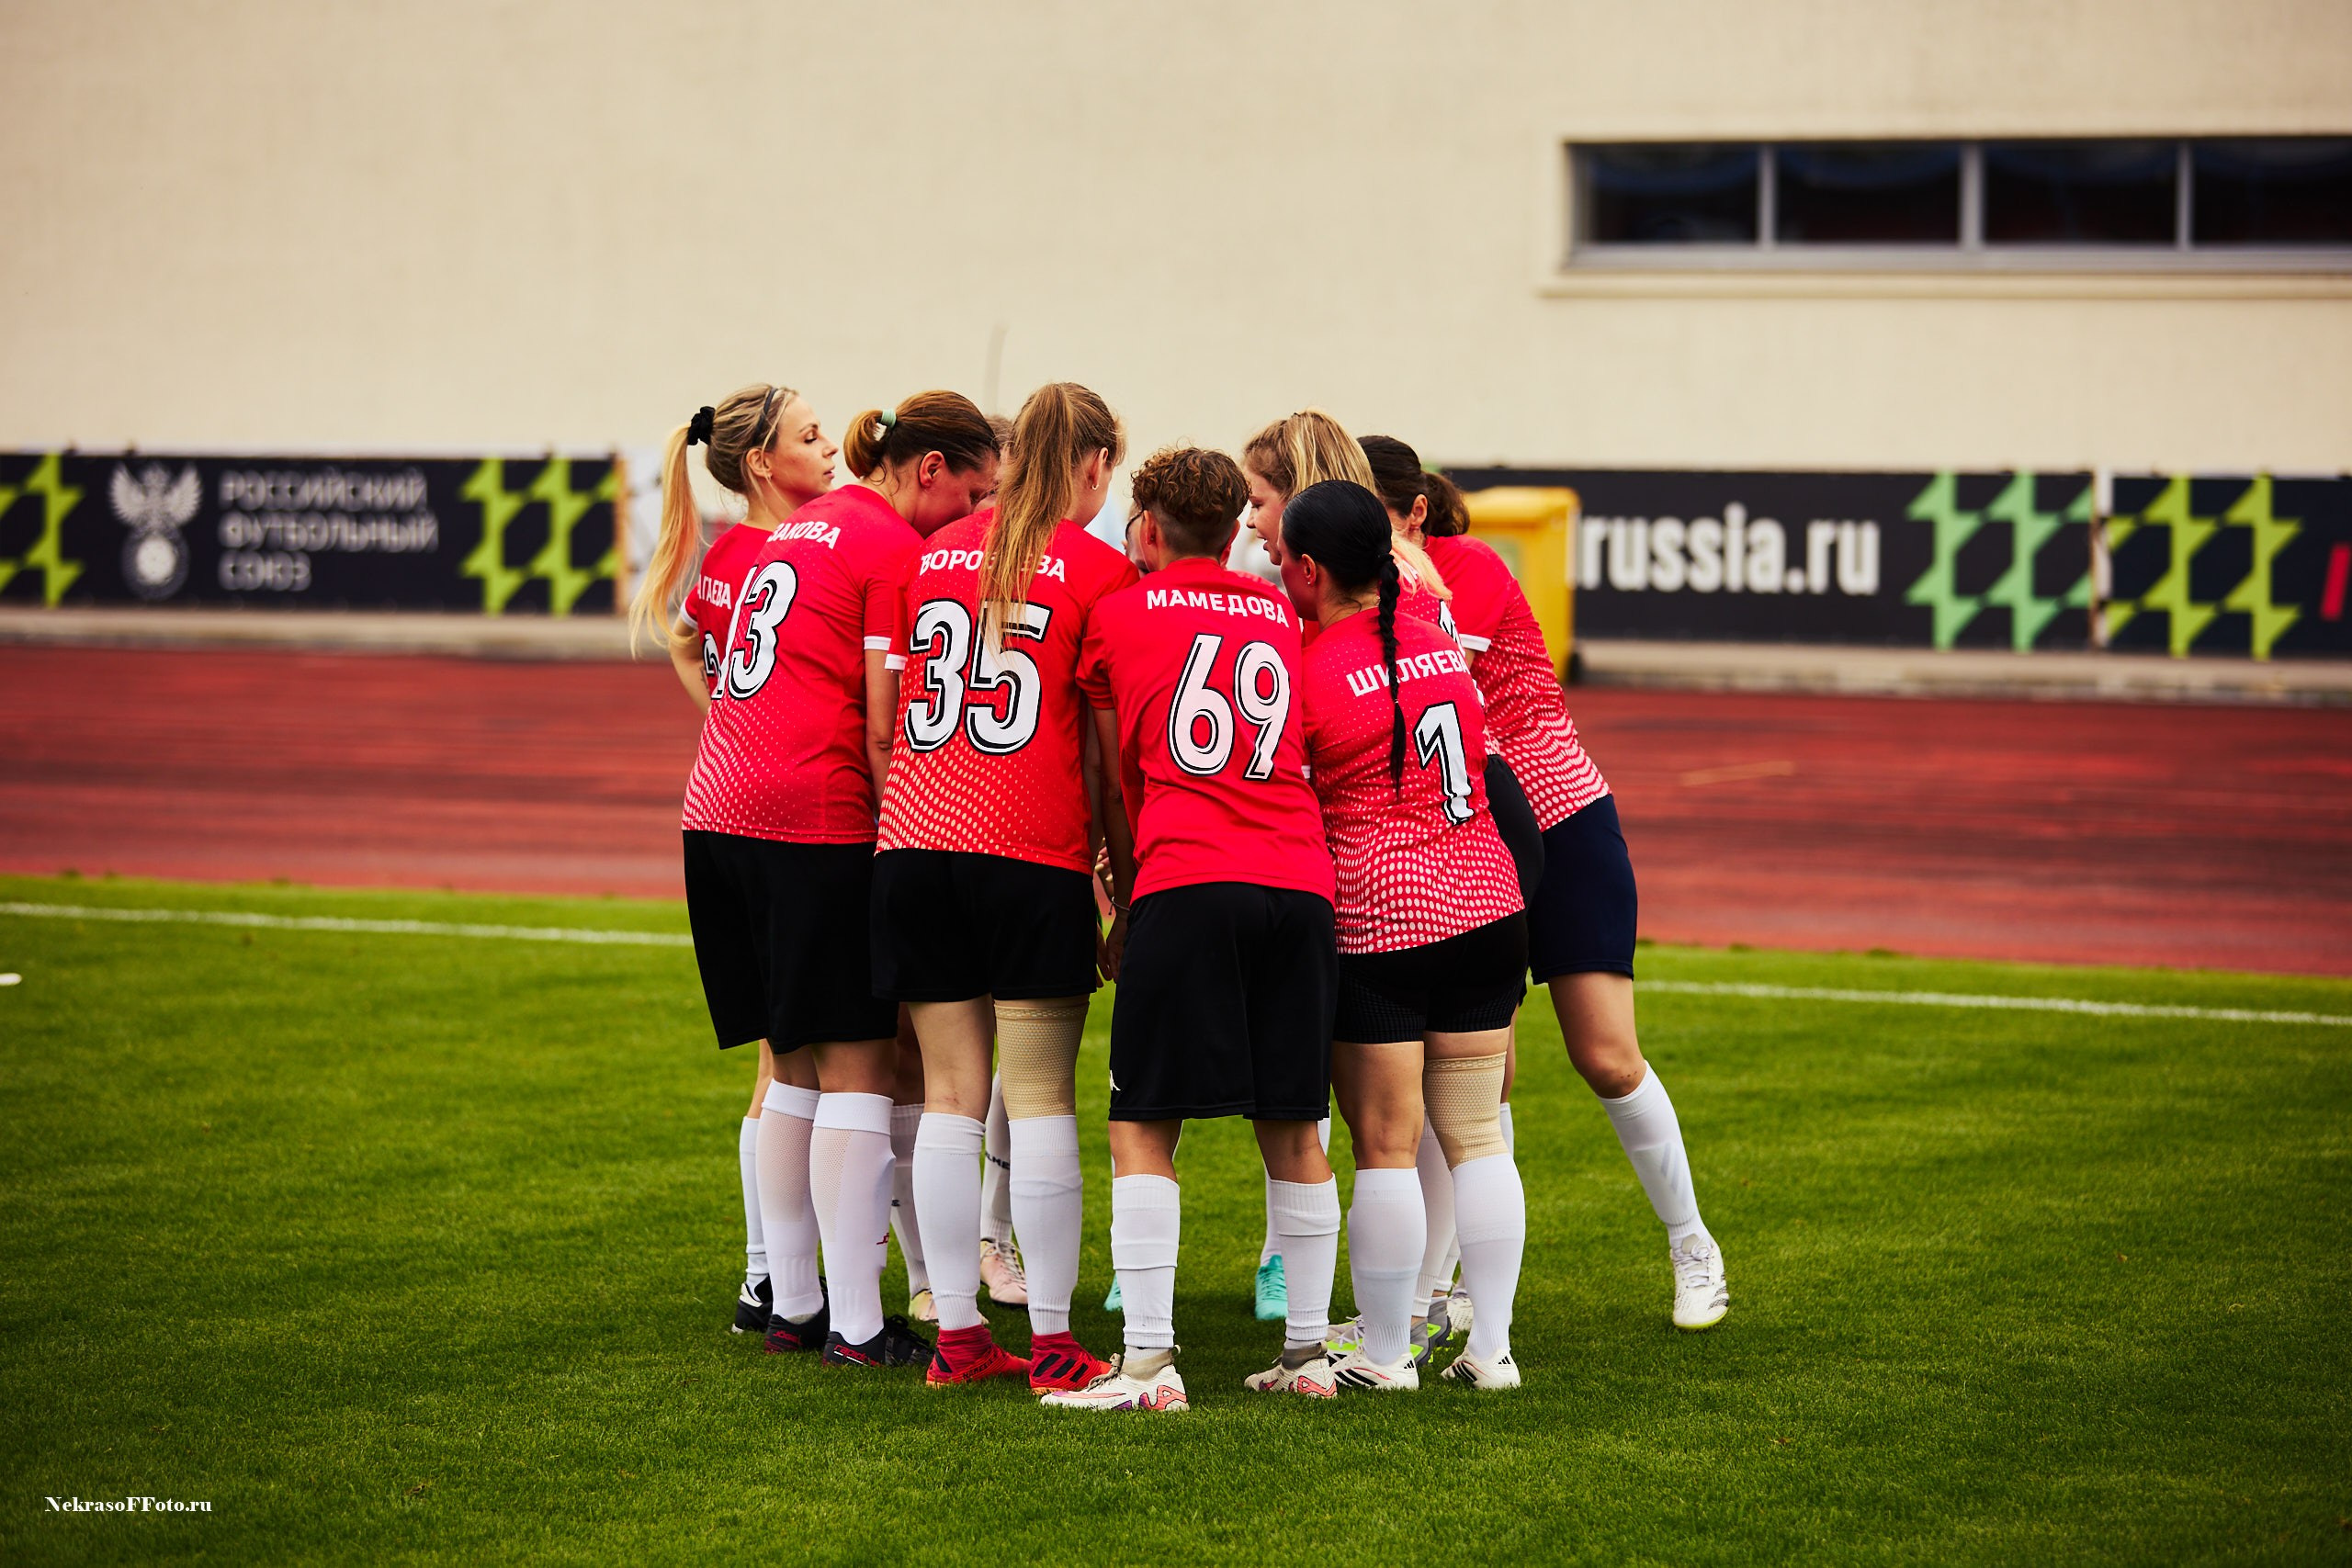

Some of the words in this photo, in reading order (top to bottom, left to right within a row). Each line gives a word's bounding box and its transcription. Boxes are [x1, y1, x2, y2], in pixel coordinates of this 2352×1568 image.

[220, 467, 427, 508] РОССИЙСКИЙ
[220, 510, 438, 550] ФУТБОЛЬНЫЙ
[220, 553, 311, 591] СОЮЗ
[920, 549, 1065, 583] ВОРОВА
[1146, 589, 1289, 628] МАМЕДОВА
[904, 598, 1053, 756] 35
[1167, 632, 1291, 782] 69
[1412, 699, 1475, 826] 1
